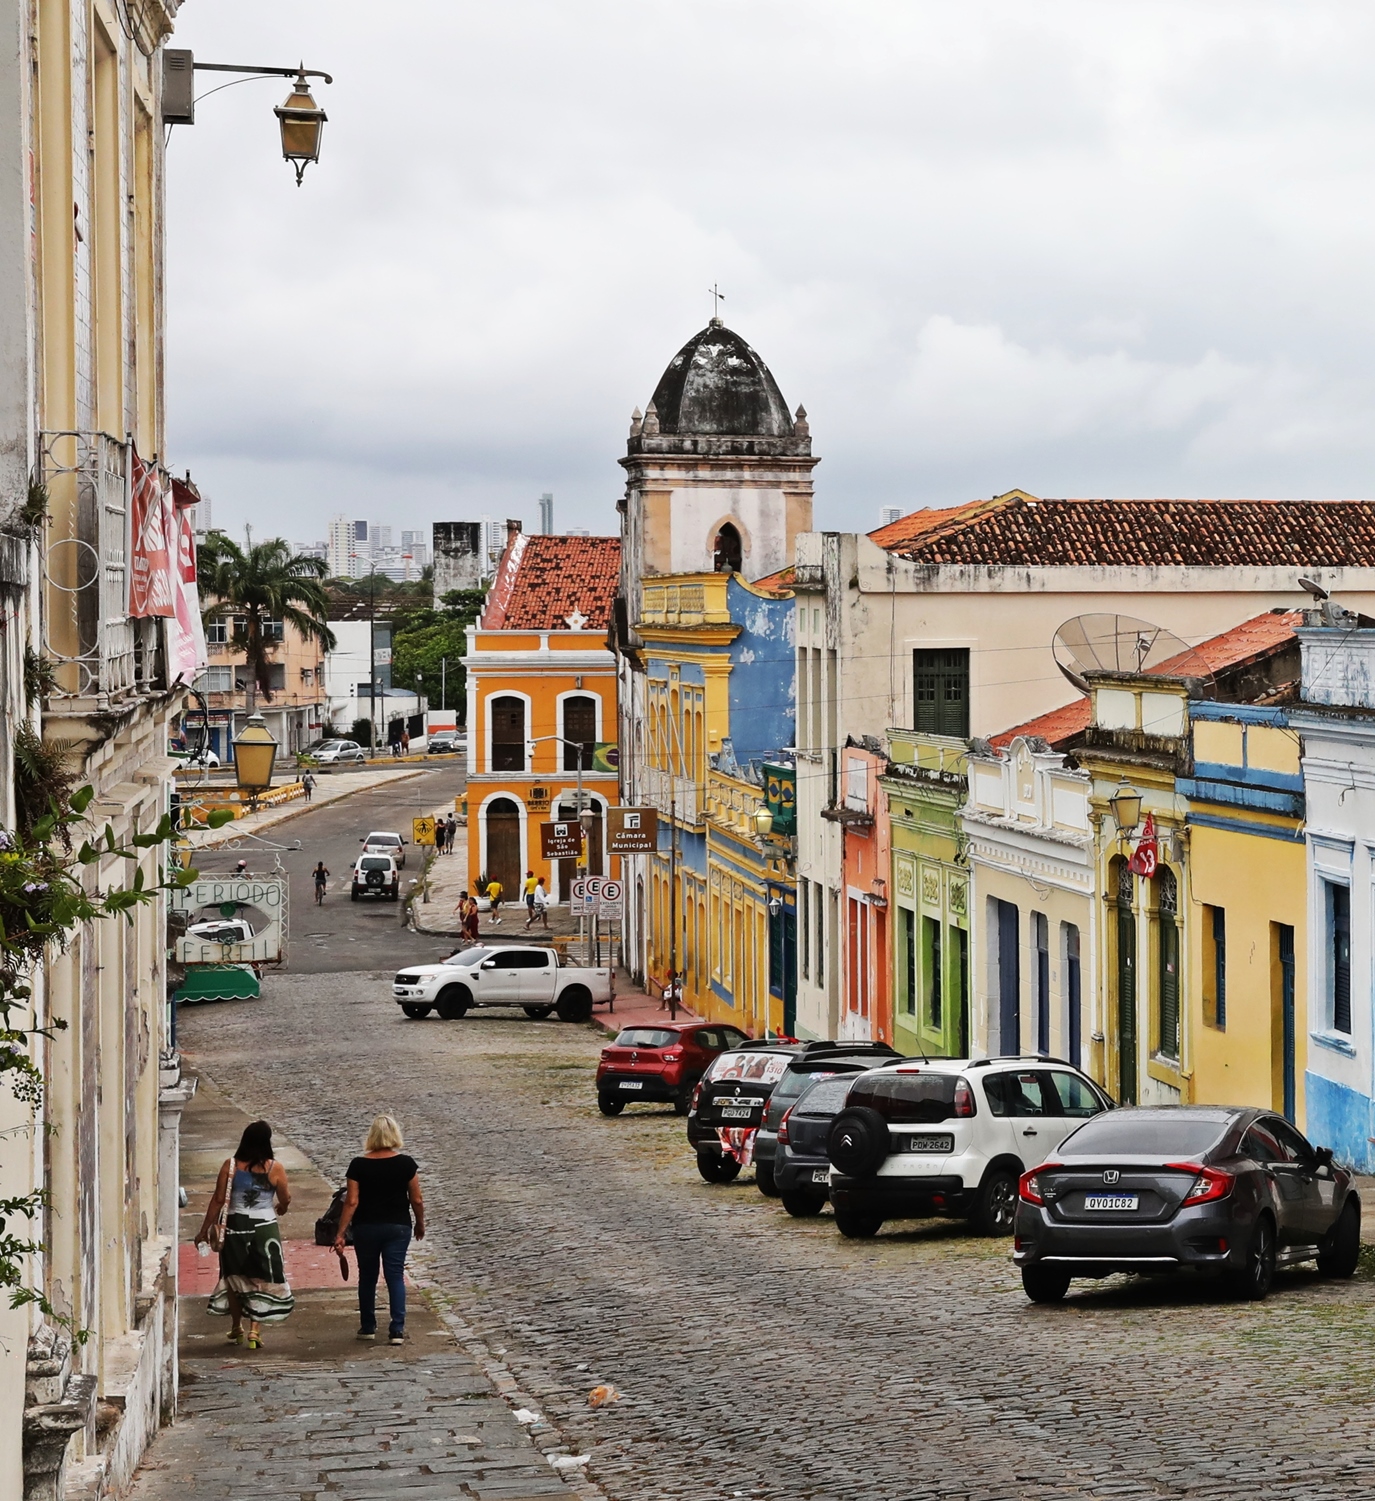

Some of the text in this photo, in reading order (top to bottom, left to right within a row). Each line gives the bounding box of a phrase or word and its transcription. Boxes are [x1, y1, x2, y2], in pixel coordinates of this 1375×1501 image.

[1140, 849, 1155, 874] 13
[181, 883, 281, 908] PERIODO
[592, 882, 600, 892] E
[607, 886, 615, 897] E
[183, 939, 276, 963] FERTIL
